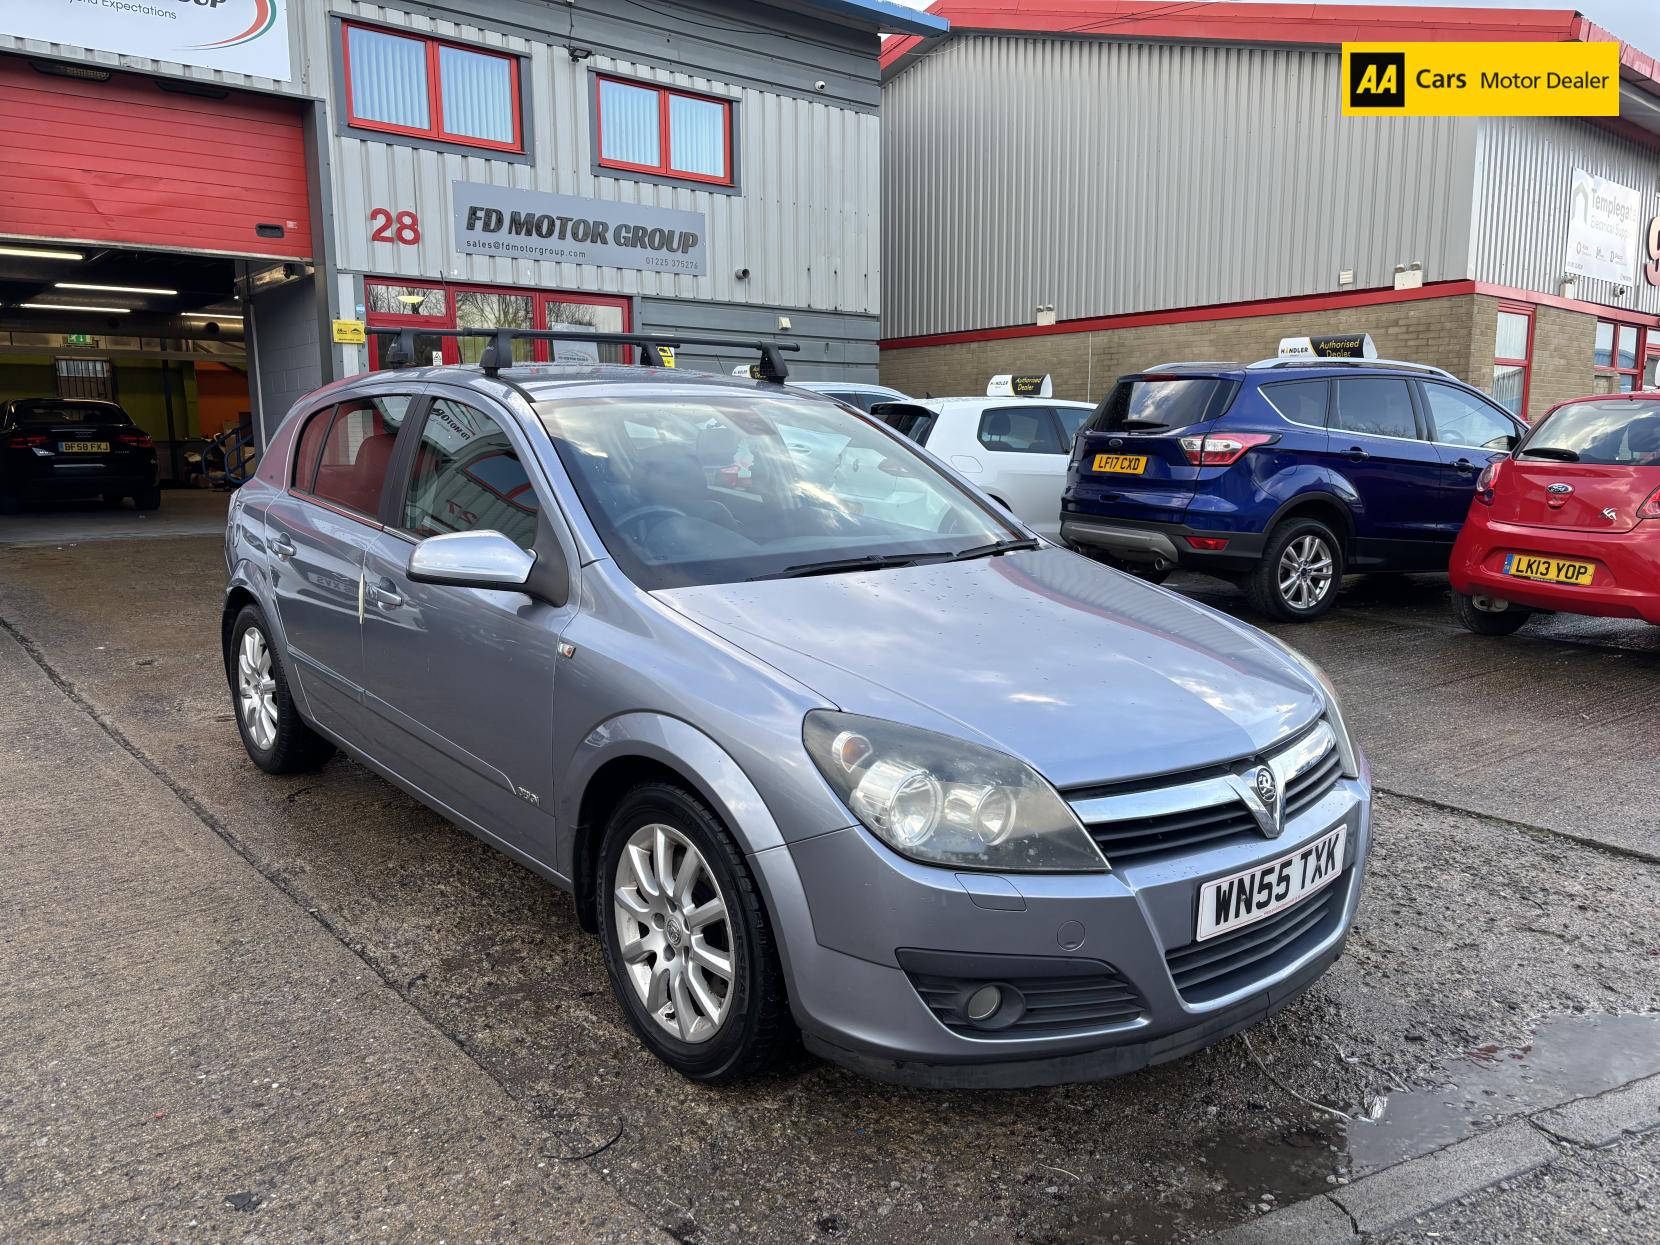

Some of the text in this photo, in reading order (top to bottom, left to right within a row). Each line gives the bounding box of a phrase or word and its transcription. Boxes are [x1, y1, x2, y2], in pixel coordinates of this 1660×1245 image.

[370, 207, 421, 246] 28
[466, 205, 699, 254] FD MOTOR GROUP
[466, 240, 586, 259] sales@fdmotorgroup.com
[1319, 339, 1360, 350] Authorised
[1098, 456, 1141, 471] LF17 CXD
[1515, 558, 1588, 581] LK13 YOP
[1215, 833, 1340, 926] WN55 TXK
